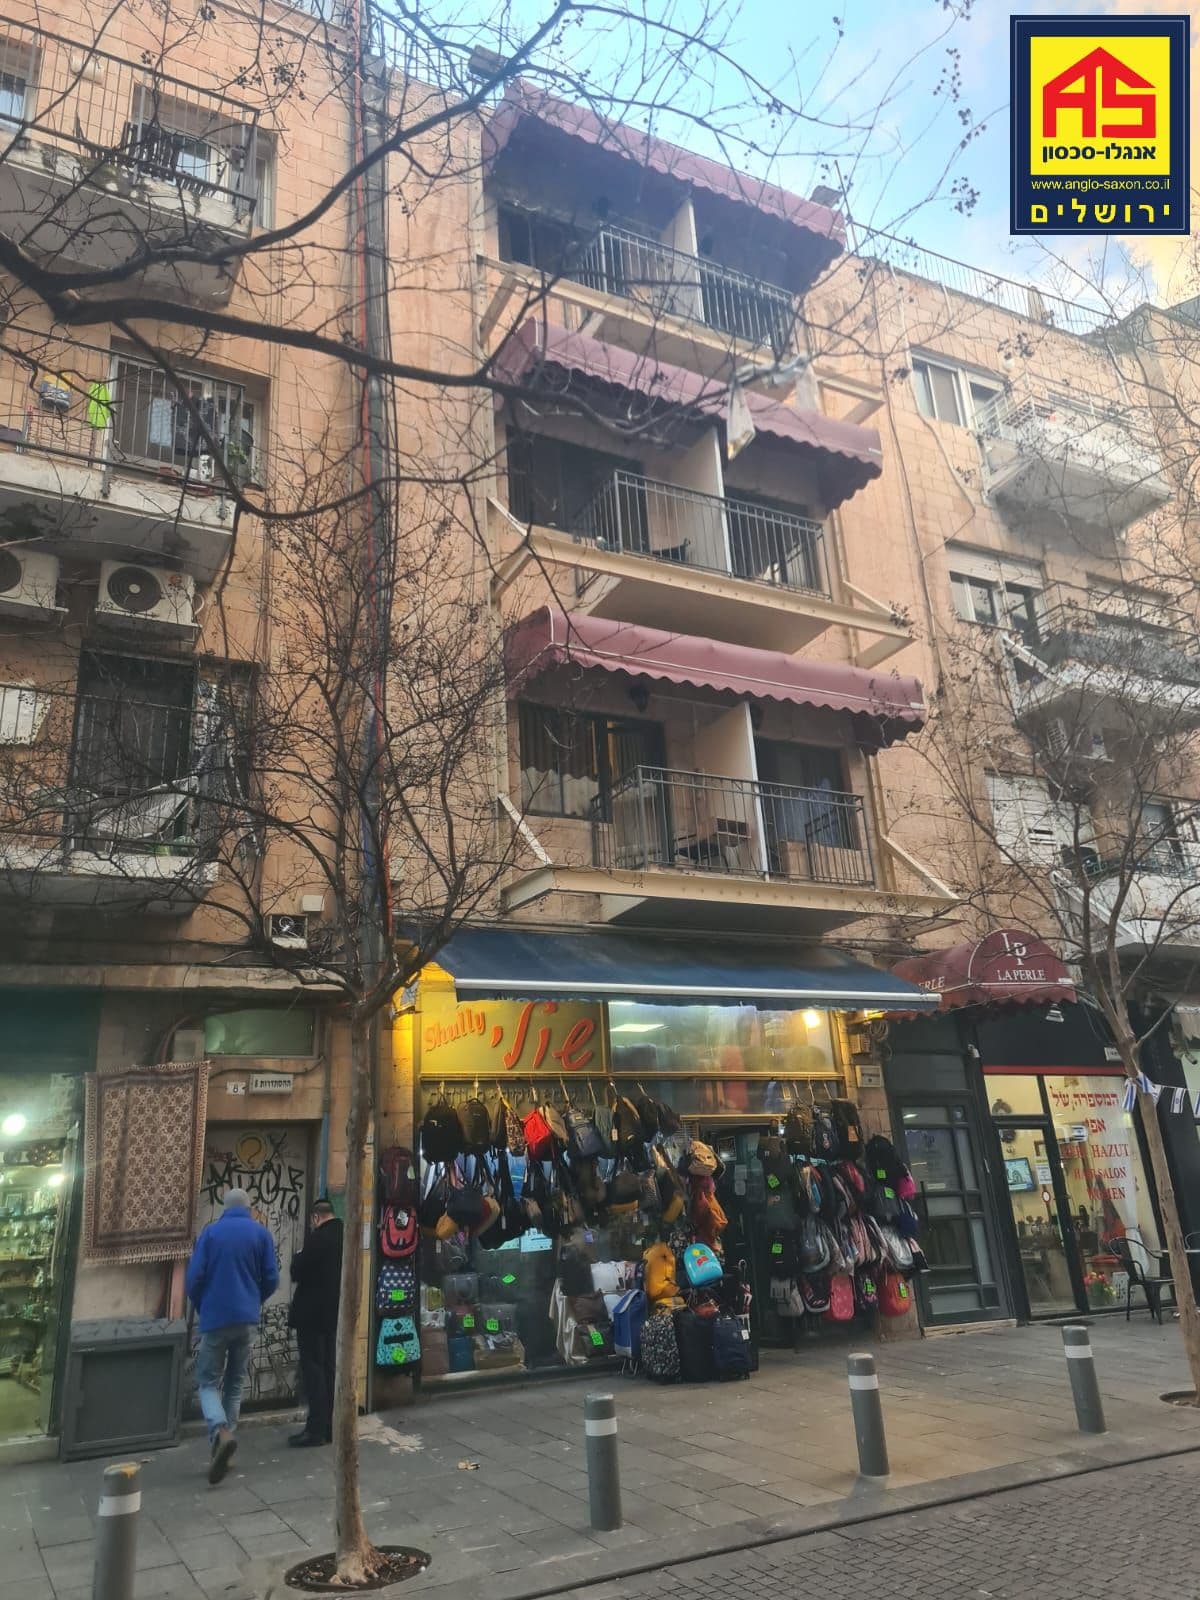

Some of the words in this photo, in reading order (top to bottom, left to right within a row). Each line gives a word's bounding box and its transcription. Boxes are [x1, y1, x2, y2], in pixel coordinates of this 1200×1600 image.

[997, 969, 1011, 981] LA
[1012, 969, 1047, 981] PERLE
[423, 1006, 486, 1052] Shully
[1091, 1143, 1129, 1158] HAZUT
